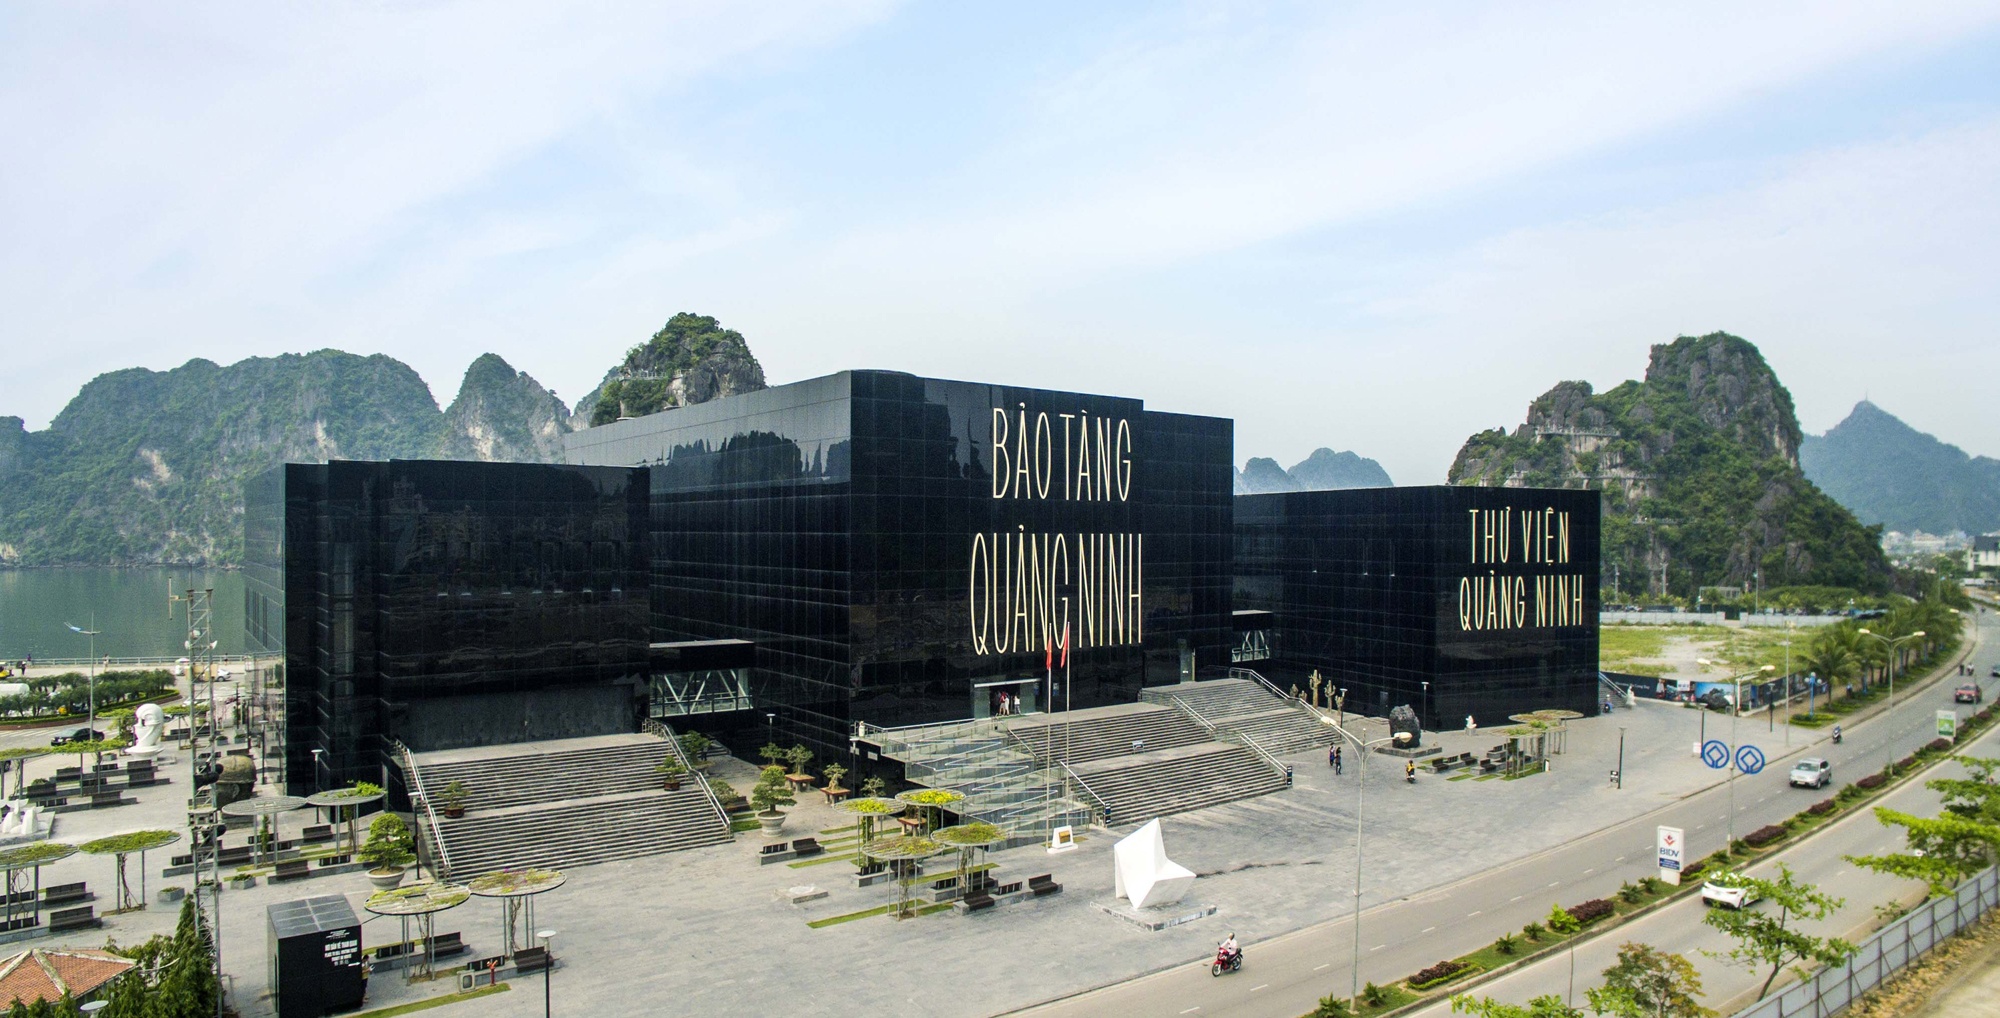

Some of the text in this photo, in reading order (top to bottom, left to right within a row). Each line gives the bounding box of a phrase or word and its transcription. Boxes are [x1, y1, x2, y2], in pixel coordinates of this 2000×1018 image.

[992, 402, 1132, 502] BẢO TÀNG
[1469, 506, 1570, 566] THƯ VIỆN
[970, 524, 1143, 656] QUẢNG NINH
[1459, 570, 1583, 631] QUẢNG NINH
[1660, 848, 1680, 857] BIDV
